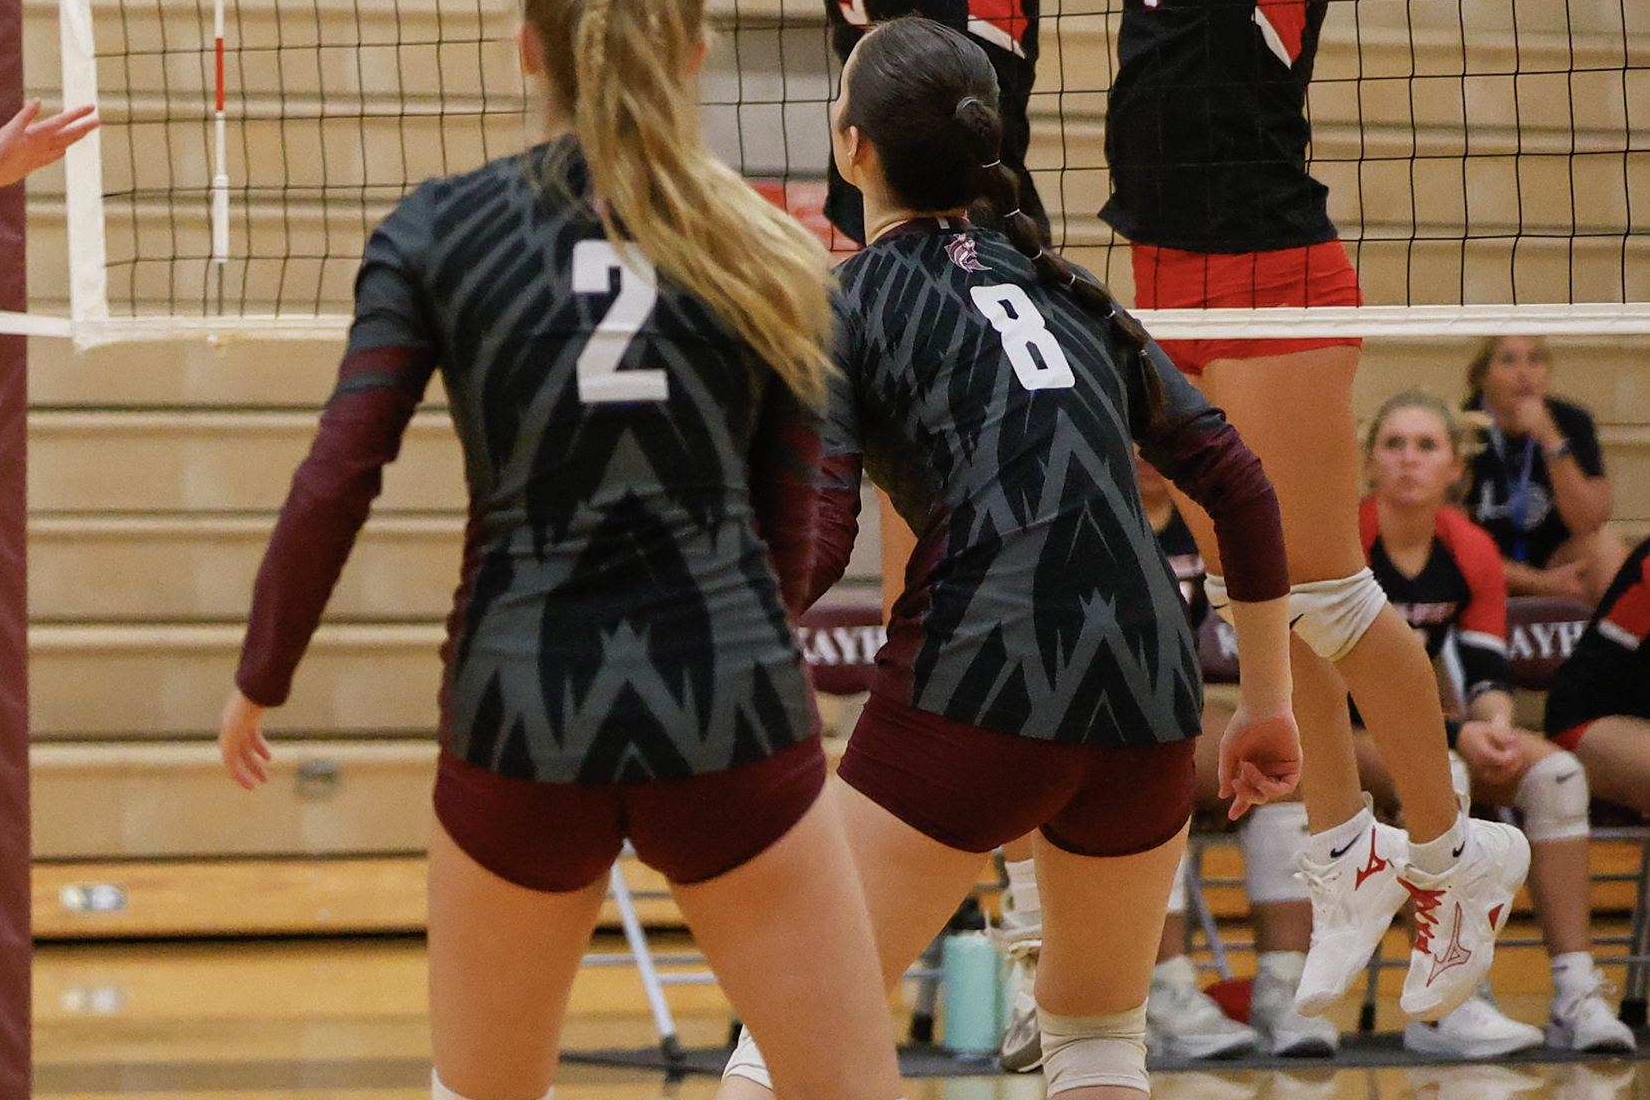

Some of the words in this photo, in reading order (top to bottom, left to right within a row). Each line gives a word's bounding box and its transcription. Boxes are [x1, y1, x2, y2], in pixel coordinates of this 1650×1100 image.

[571, 238, 670, 403] 2
[969, 282, 1076, 391] 8
[1509, 620, 1591, 658] AYH
